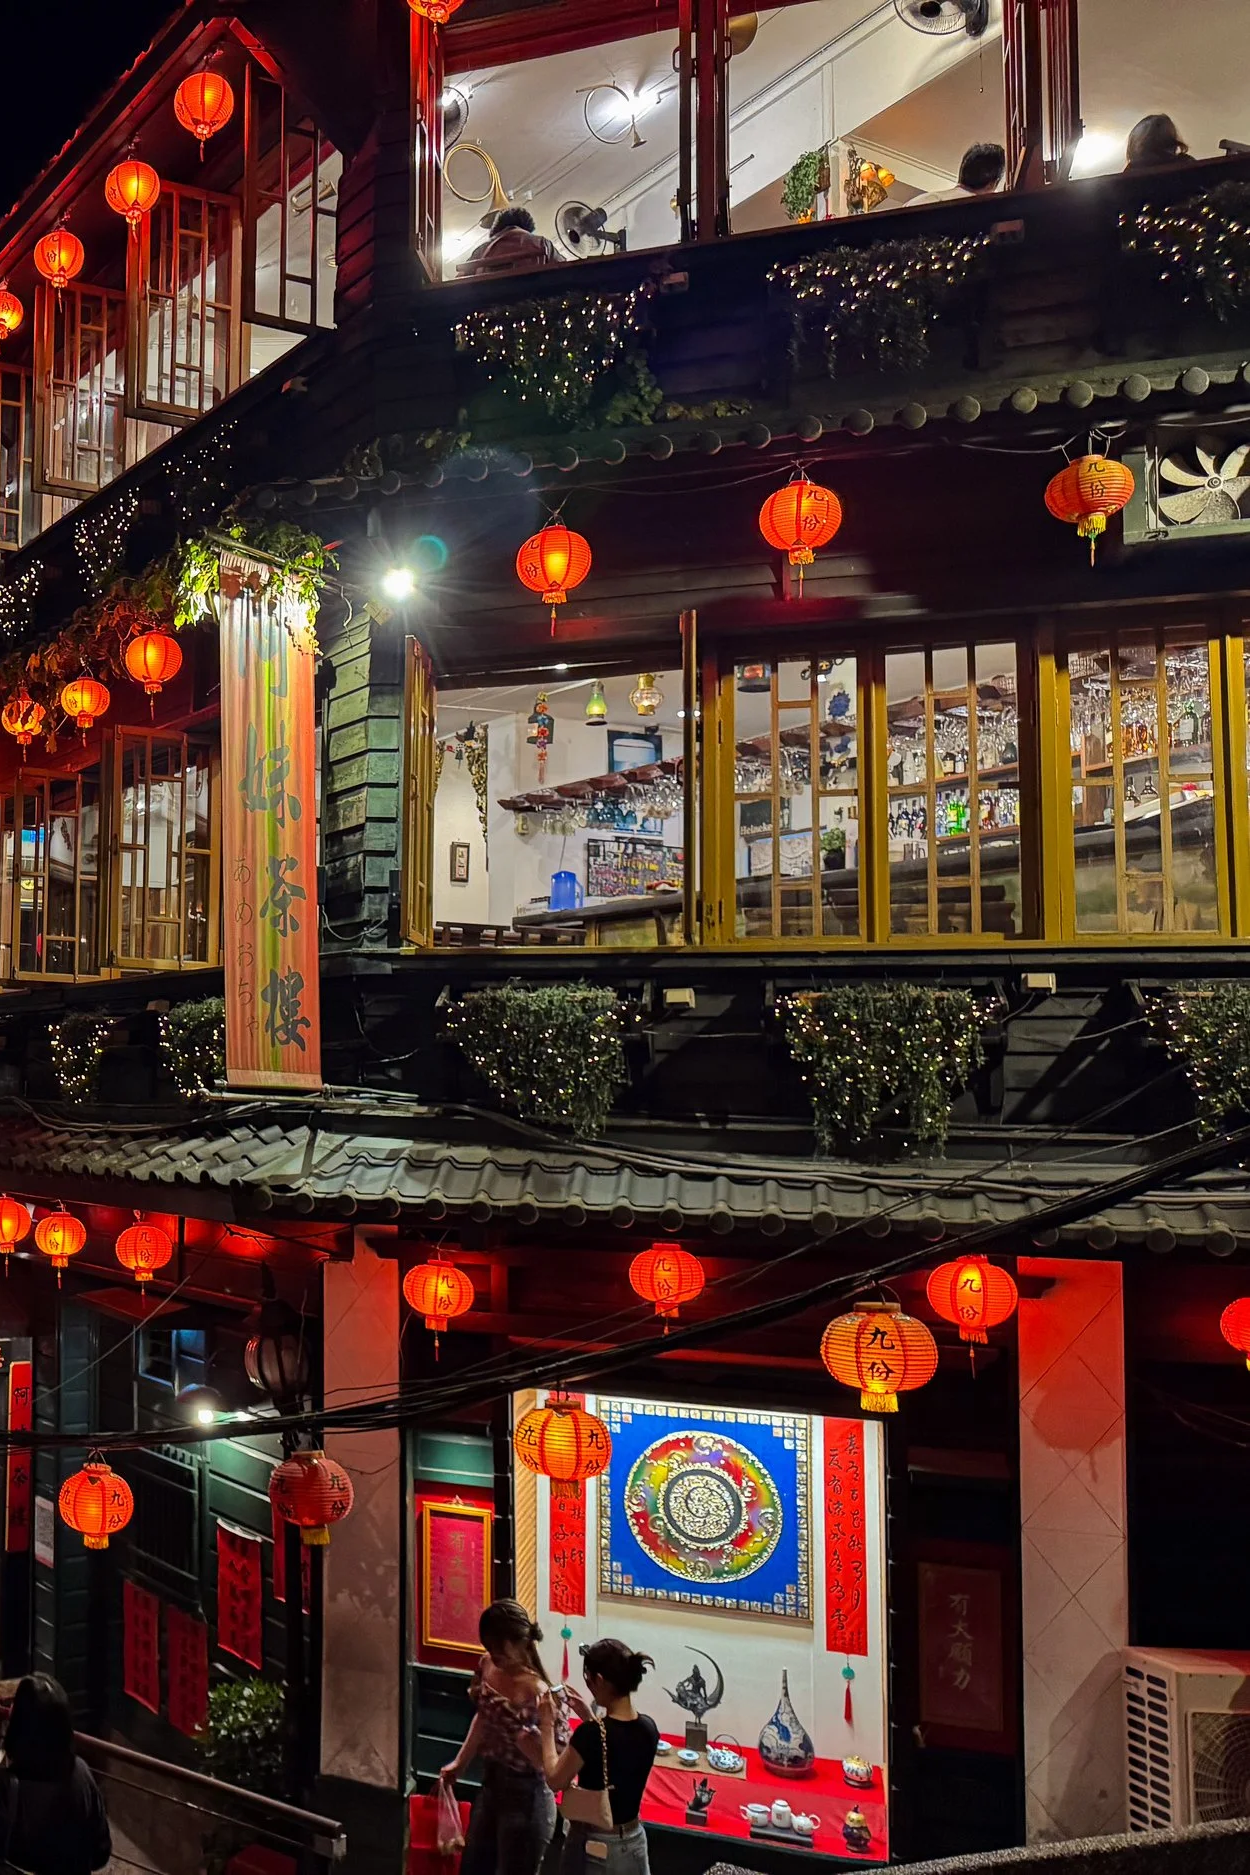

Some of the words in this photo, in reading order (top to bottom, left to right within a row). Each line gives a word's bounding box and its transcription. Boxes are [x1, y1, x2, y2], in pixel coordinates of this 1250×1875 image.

[802, 489, 826, 531] 九份
[655, 1258, 672, 1298] 九份
[959, 1278, 982, 1321] 九份
[866, 1326, 896, 1371] 九份
[582, 1429, 605, 1474] 九份
[107, 1489, 125, 1529] 九份
